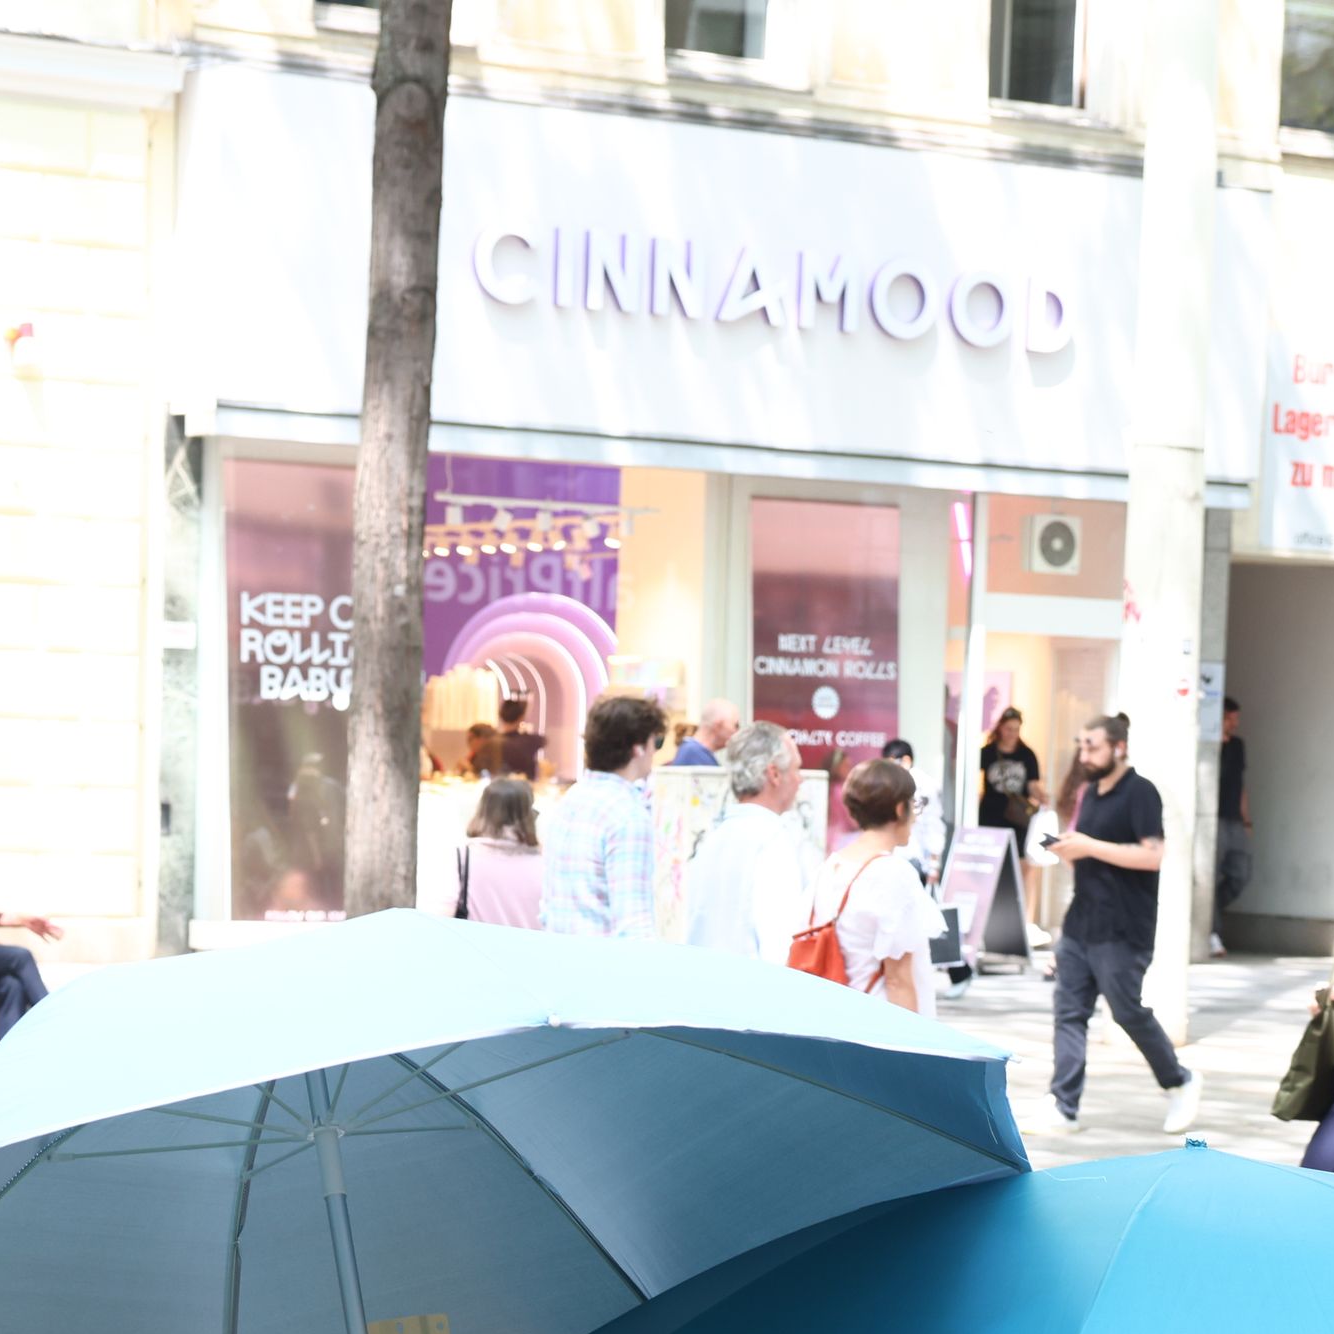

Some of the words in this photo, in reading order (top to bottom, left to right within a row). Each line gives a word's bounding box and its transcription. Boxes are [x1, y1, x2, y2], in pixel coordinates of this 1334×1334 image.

[473, 226, 1070, 353] CINNAMOOD
[1291, 460, 1314, 487] zu
[240, 591, 325, 628] KEEP
[240, 628, 354, 665] ROLLI
[778, 633, 816, 652] NEXT
[822, 636, 873, 656] LEVEL
[754, 656, 839, 678] CINNAMON
[843, 660, 898, 681] ROLLS
[835, 730, 886, 747] COFFEE
